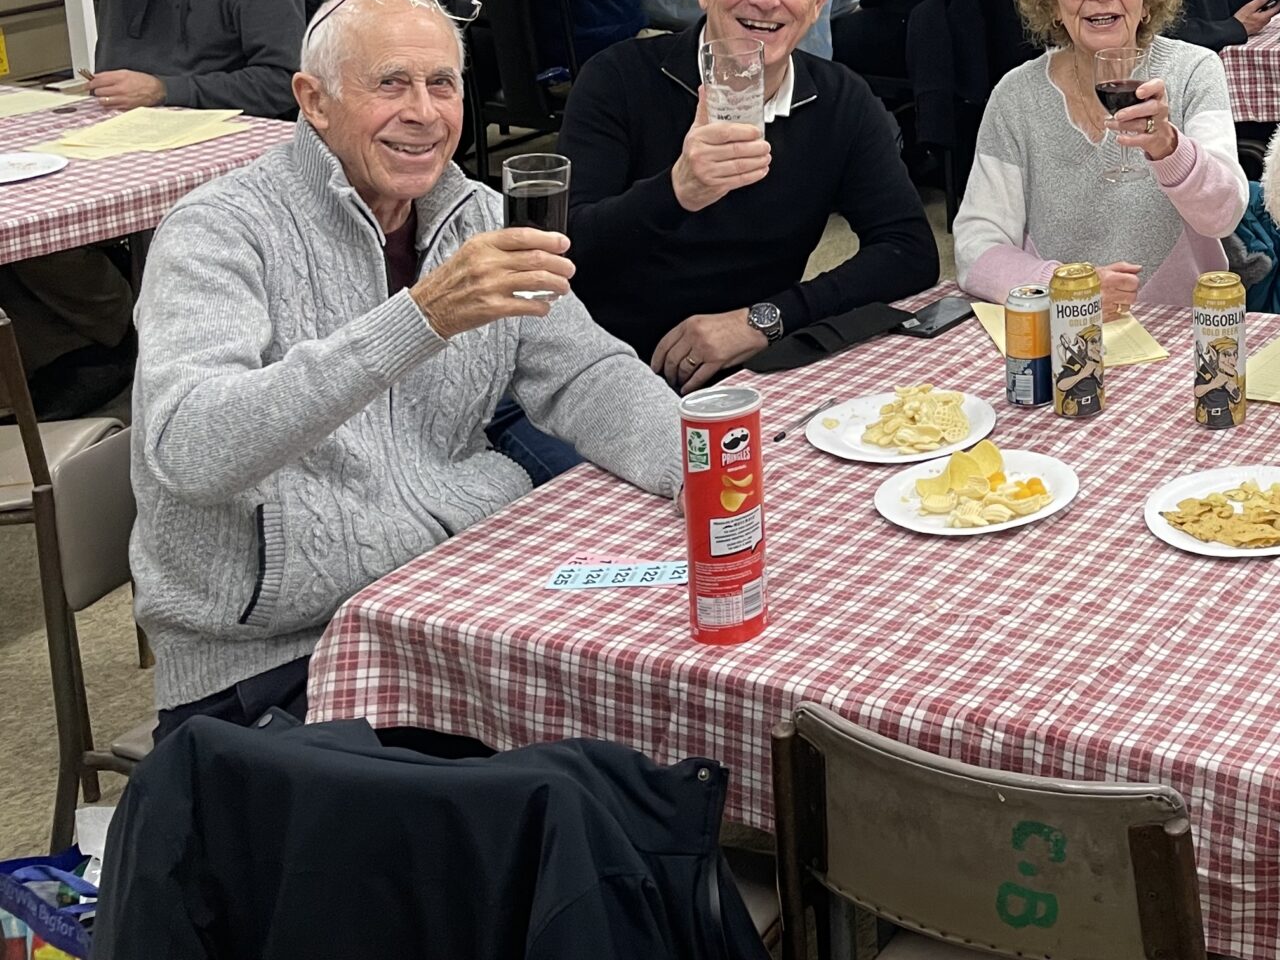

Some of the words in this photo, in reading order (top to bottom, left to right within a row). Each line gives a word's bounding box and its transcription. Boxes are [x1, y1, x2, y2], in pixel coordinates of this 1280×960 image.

[1194, 311, 1246, 327] HOBGOBLIN
[1202, 327, 1220, 336] GOLD
[1221, 327, 1239, 336] BEER
[722, 447, 751, 467] PRINGLES
[553, 568, 576, 586] 125
[581, 568, 604, 585] 124
[611, 567, 633, 584] 123
[639, 566, 661, 583] 122
[669, 564, 688, 581] 121
